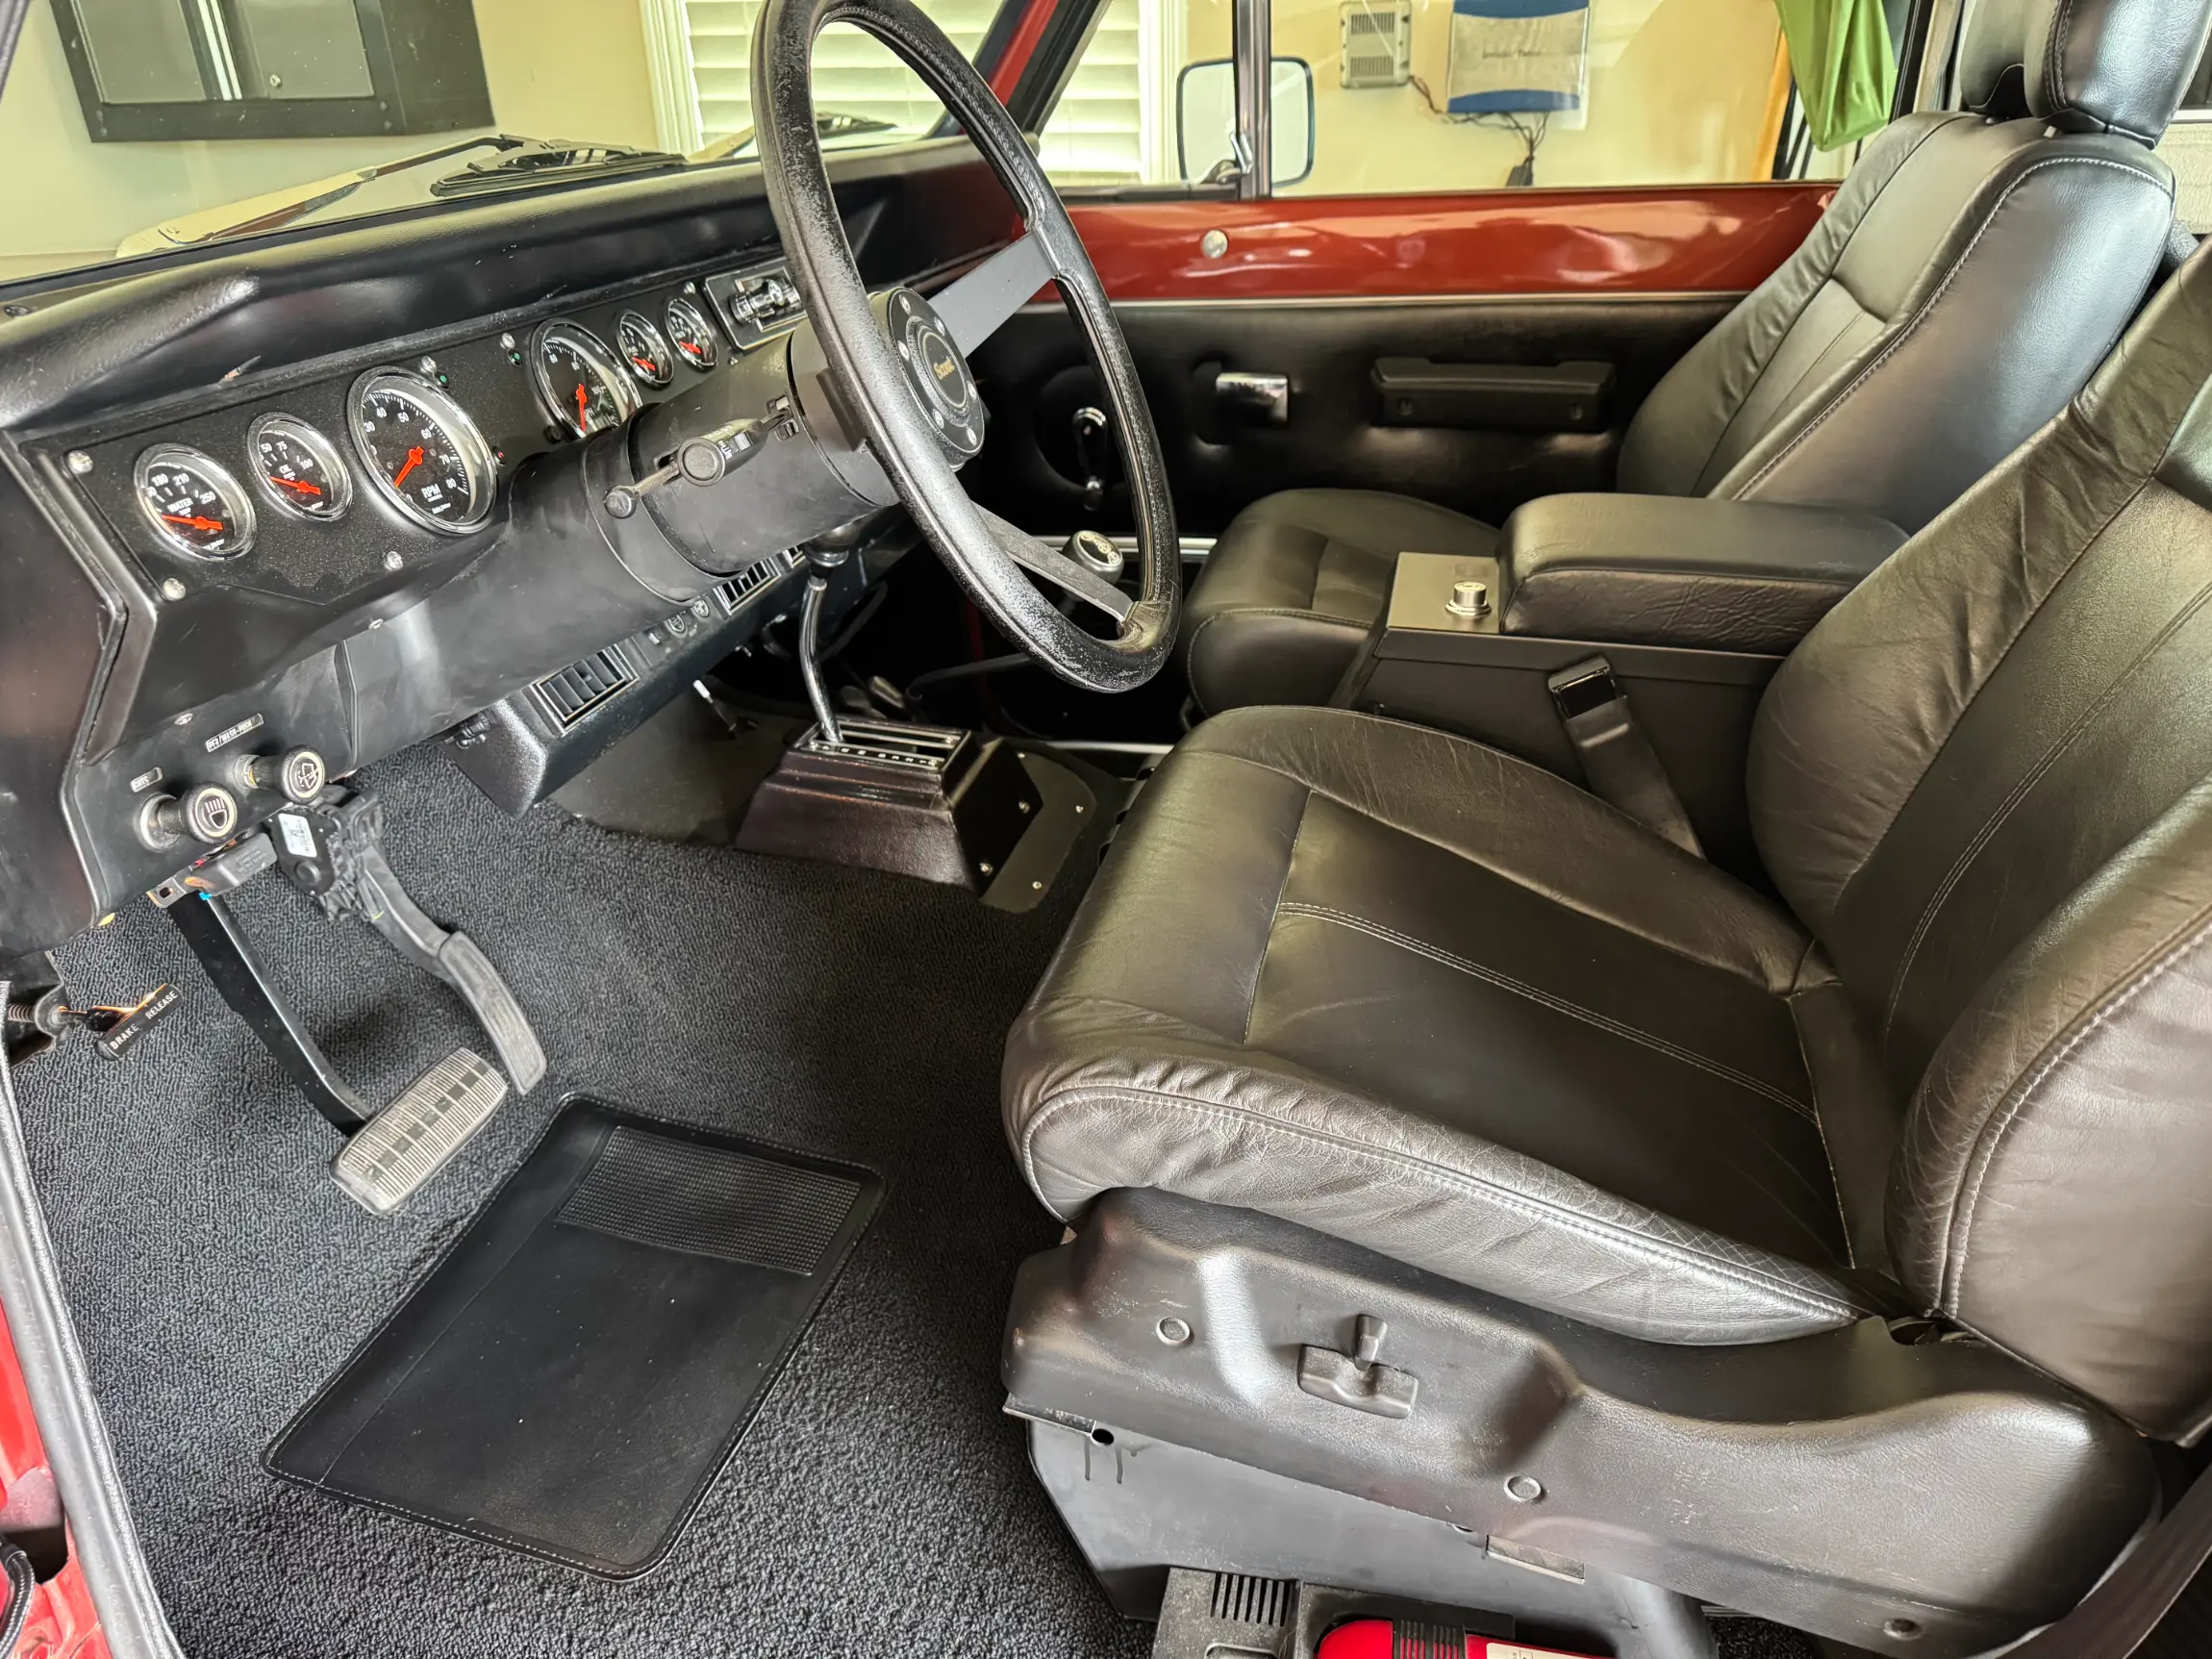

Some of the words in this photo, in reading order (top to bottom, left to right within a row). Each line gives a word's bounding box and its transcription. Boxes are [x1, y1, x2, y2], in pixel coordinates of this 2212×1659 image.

[376, 407, 388, 417] 40
[397, 412, 410, 423] 50
[420, 428, 432, 440] 60
[260, 442, 272, 453] 50
[275, 440, 288, 451] 75
[299, 458, 314, 470] 100
[439, 454, 451, 465] 70
[172, 472, 190, 487] 210
[445, 477, 457, 490] 80
[421, 483, 441, 499] RPM
[166, 497, 193, 514] WATER
[110, 1023, 139, 1049] BRAKE
[144, 991, 179, 1019] RELEASE
